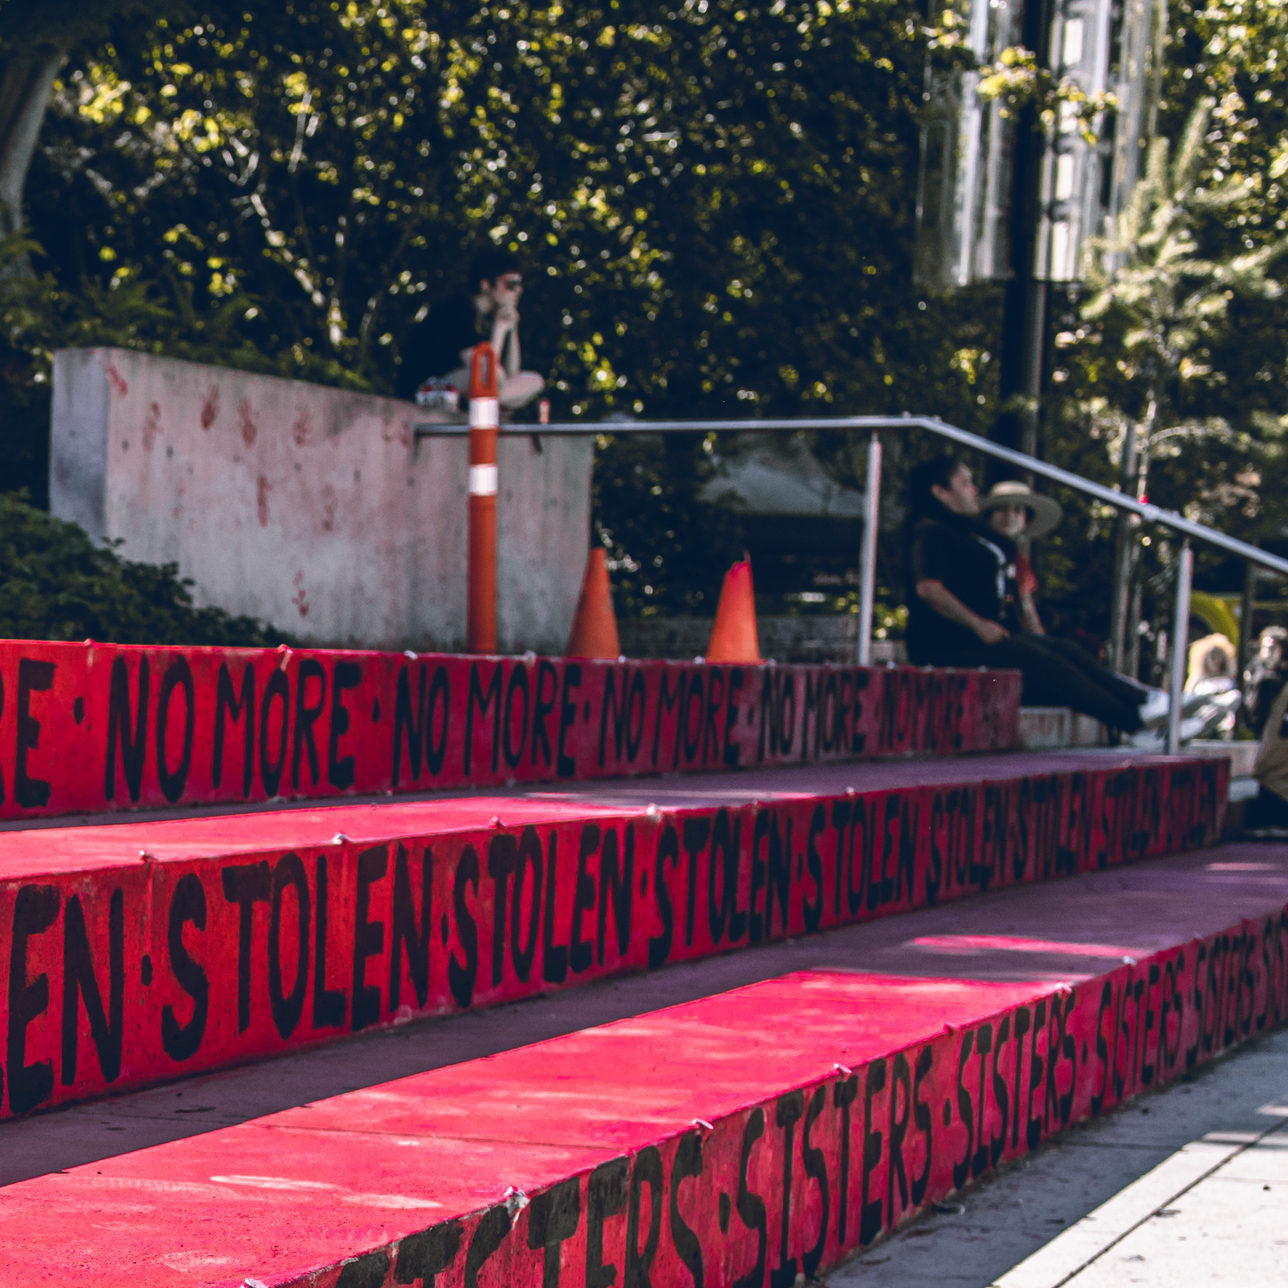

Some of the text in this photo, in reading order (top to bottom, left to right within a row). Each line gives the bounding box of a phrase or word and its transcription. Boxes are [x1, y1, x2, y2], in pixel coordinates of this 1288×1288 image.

[104, 652, 195, 802] NO
[213, 658, 362, 798] MORE
[392, 662, 450, 787] NO
[464, 661, 582, 777] MORE
[598, 665, 646, 769] NO
[652, 666, 744, 767] MORE
[161, 841, 434, 1061] STOLEN
[448, 823, 635, 1008] STOLEN
[648, 806, 793, 970] STOLEN
[803, 794, 920, 932] STOLEN
[953, 988, 1077, 1189] SISTERS
